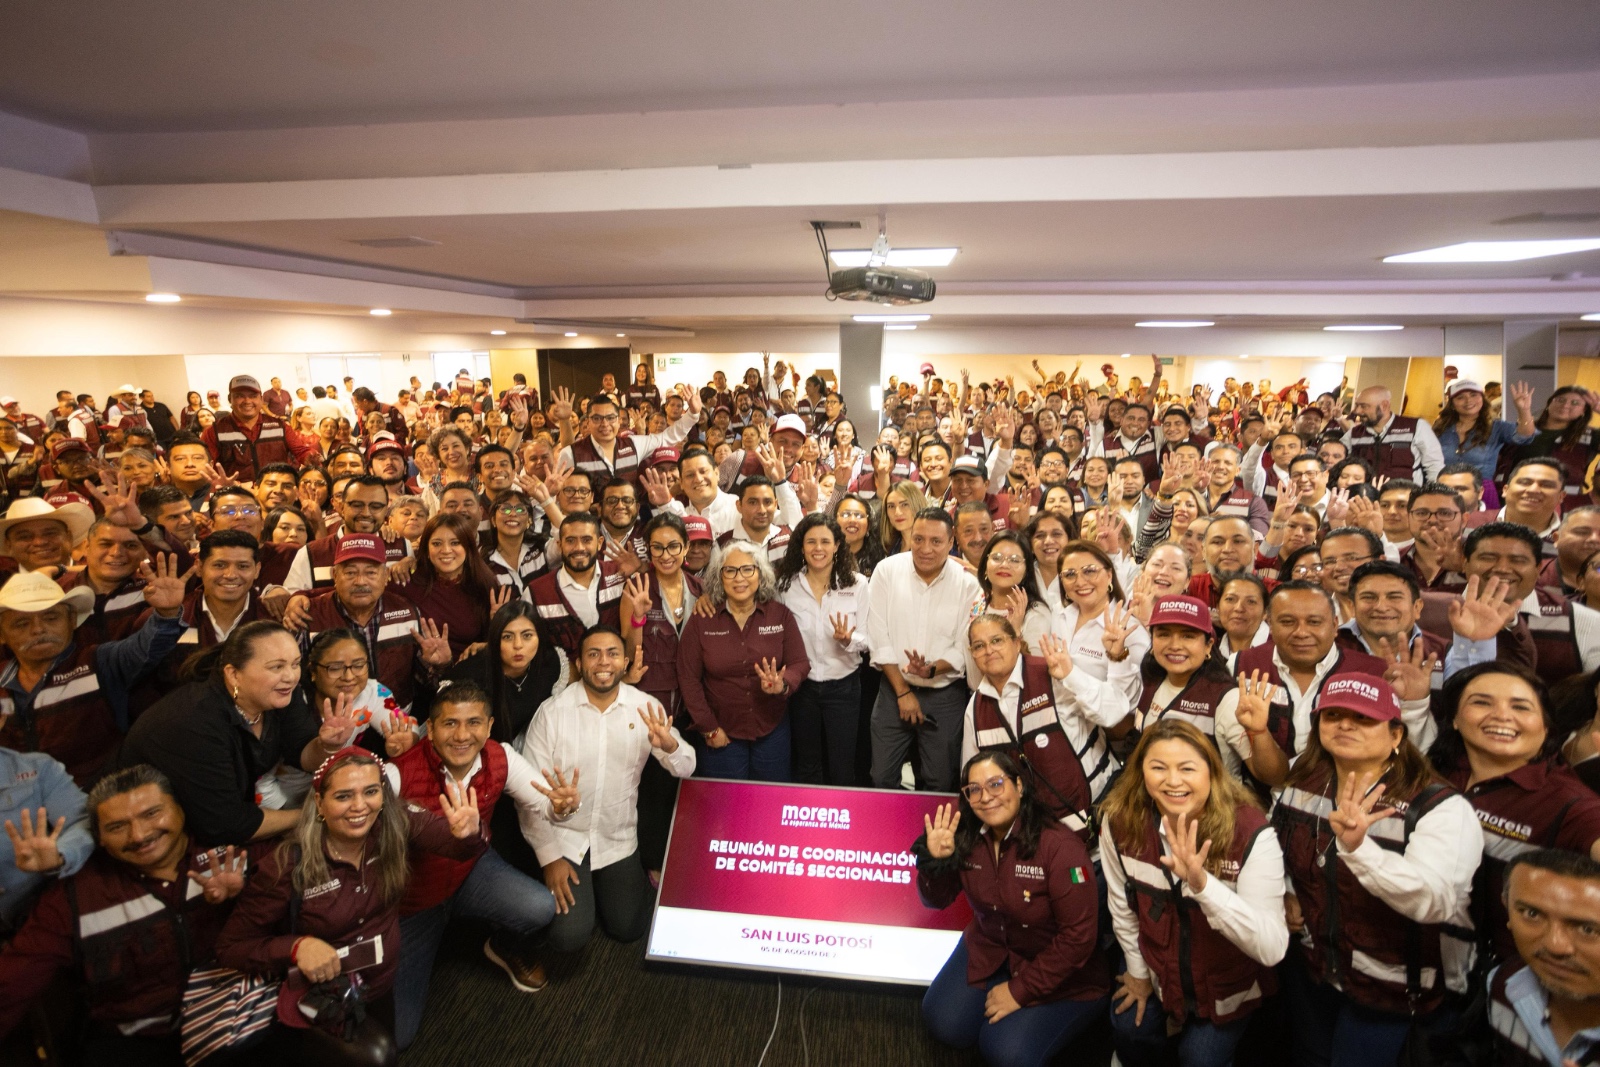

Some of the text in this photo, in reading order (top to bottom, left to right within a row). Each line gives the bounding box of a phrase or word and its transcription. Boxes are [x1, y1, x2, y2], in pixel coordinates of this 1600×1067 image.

[342, 539, 375, 548] morena
[384, 609, 410, 618] morena
[1160, 601, 1197, 612] morena
[759, 625, 783, 633] morena
[53, 664, 90, 681] morena
[1328, 681, 1379, 698] morena
[782, 805, 850, 823] morena
[709, 840, 917, 867] REUNIÓN DE COORDINACIÓN
[715, 857, 911, 884] DE COMITÉS SECCIONALES
[1016, 864, 1044, 876] morena
[304, 879, 340, 896] morena
[741, 928, 873, 949] SAN LUIS POTOSÍ
[785, 948, 818, 957] AGOSTO
